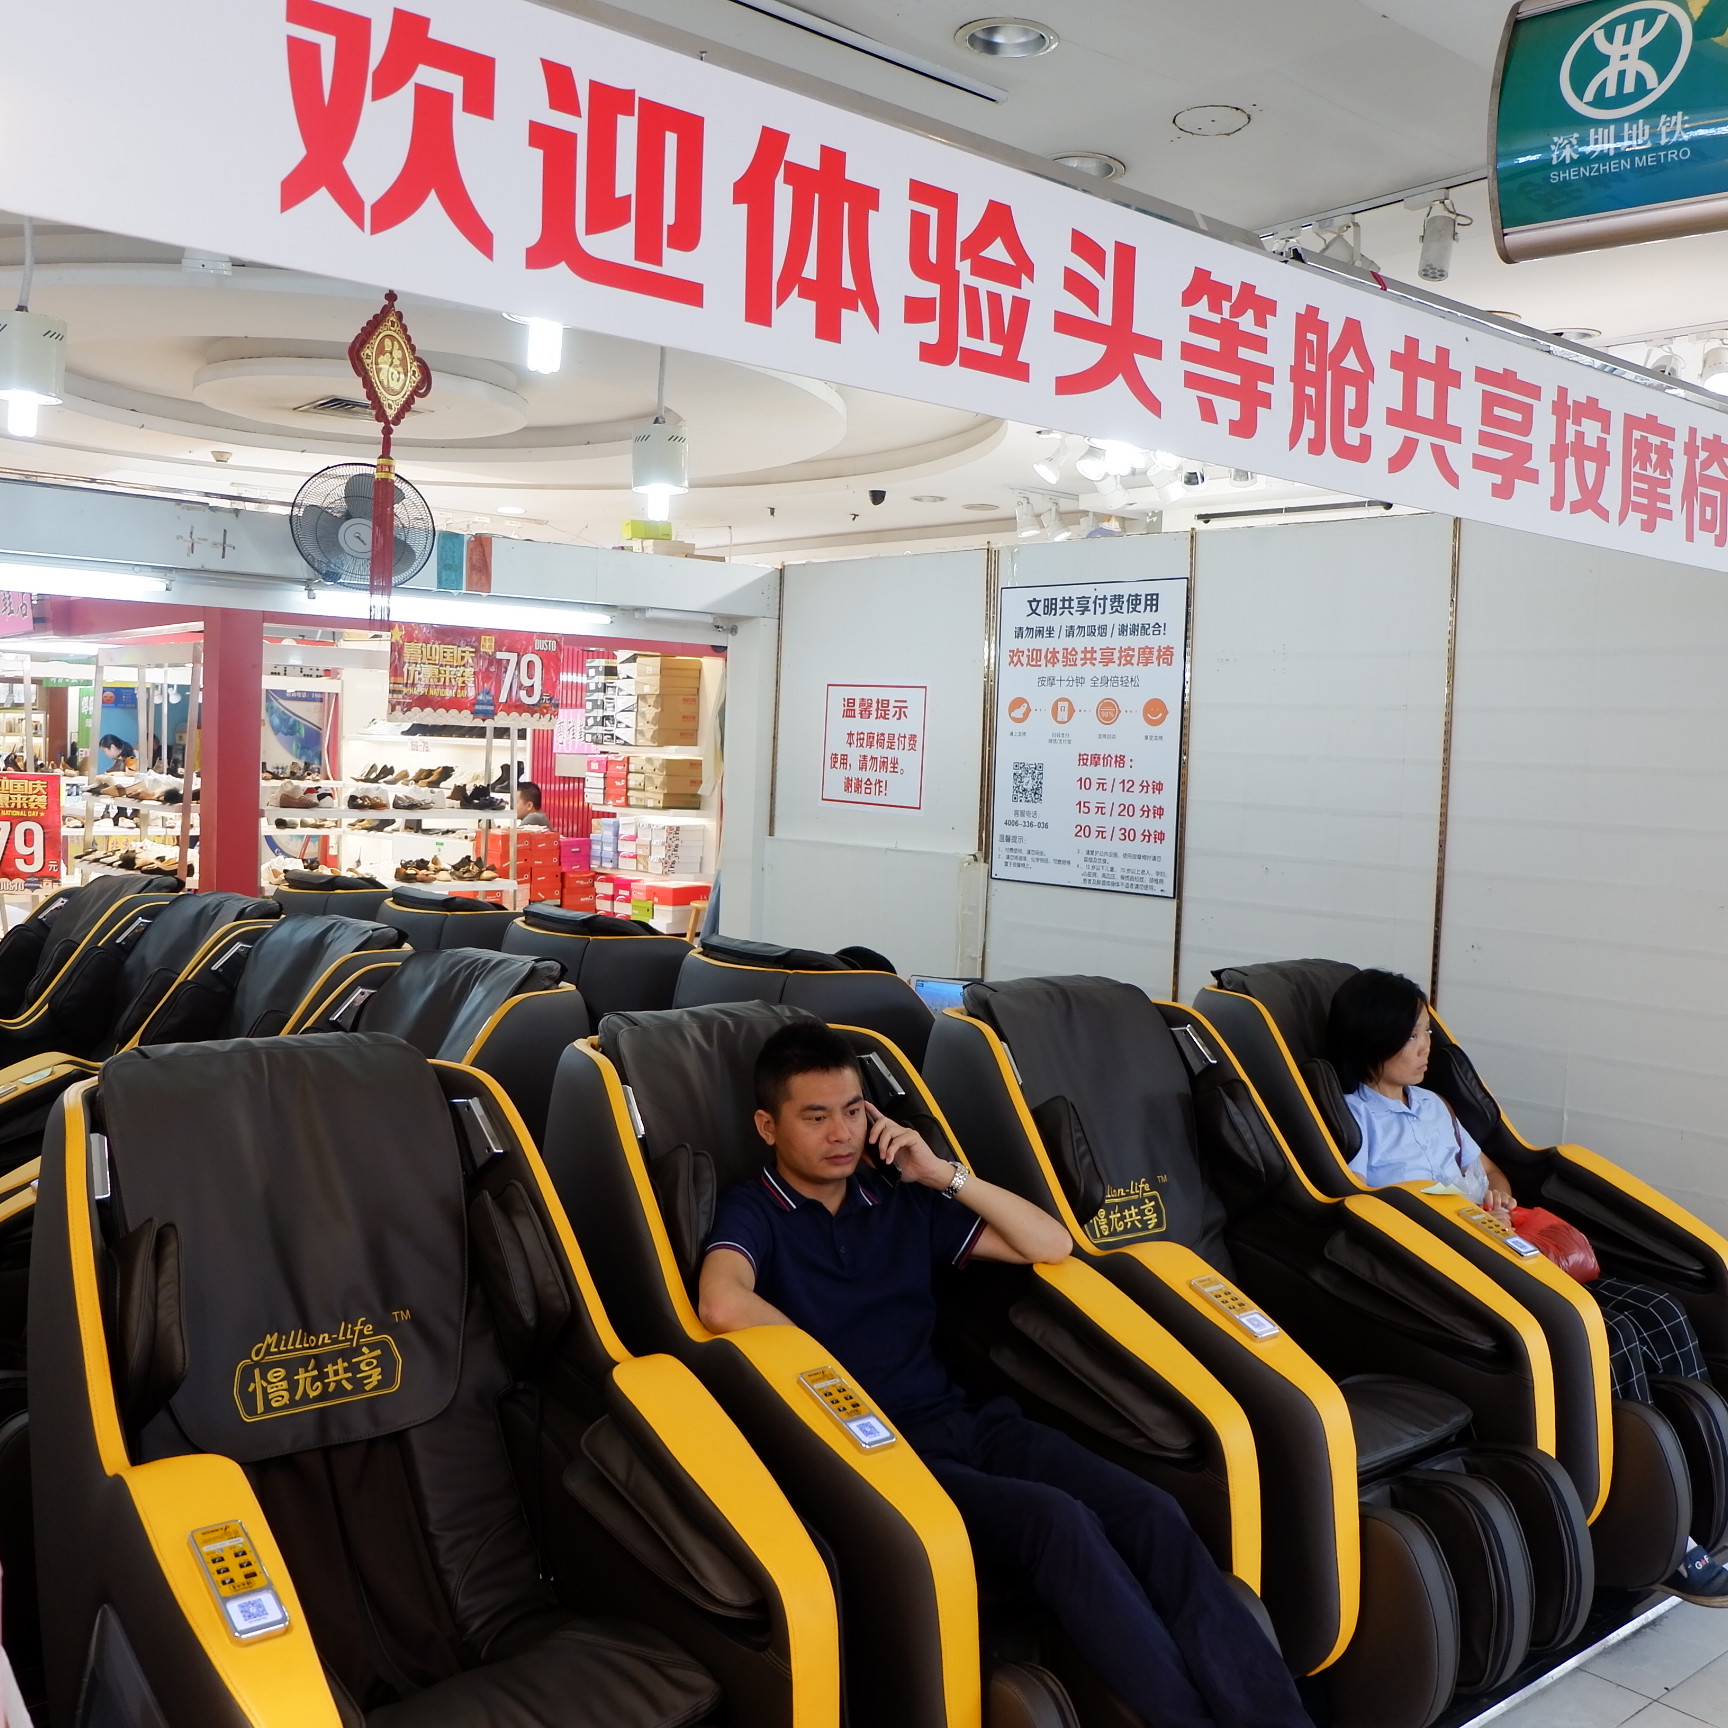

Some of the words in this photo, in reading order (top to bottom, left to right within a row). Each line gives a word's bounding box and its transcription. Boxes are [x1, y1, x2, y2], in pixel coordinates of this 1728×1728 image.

[1550, 111, 1690, 165] 深圳地铁
[1550, 158, 1631, 183] SHENZHEN
[1635, 148, 1691, 167] METRO
[281, 0, 1728, 547] 欢迎体验头等舱共享按摩椅
[1026, 593, 1160, 617] 文明共享付费使用
[403, 642, 476, 665] 喜迎国庆
[1008, 645, 1175, 667] 欢迎体验共享按摩椅
[496, 651, 543, 705] 79
[542, 693, 551, 703] 元
[842, 698, 908, 720] 温馨提示
[846, 731, 917, 751] 本按摩椅是付费
[844, 776, 888, 796] 谢谢合作!
[48, 861, 59, 872] 元
[392, 1309, 411, 1323] TM
